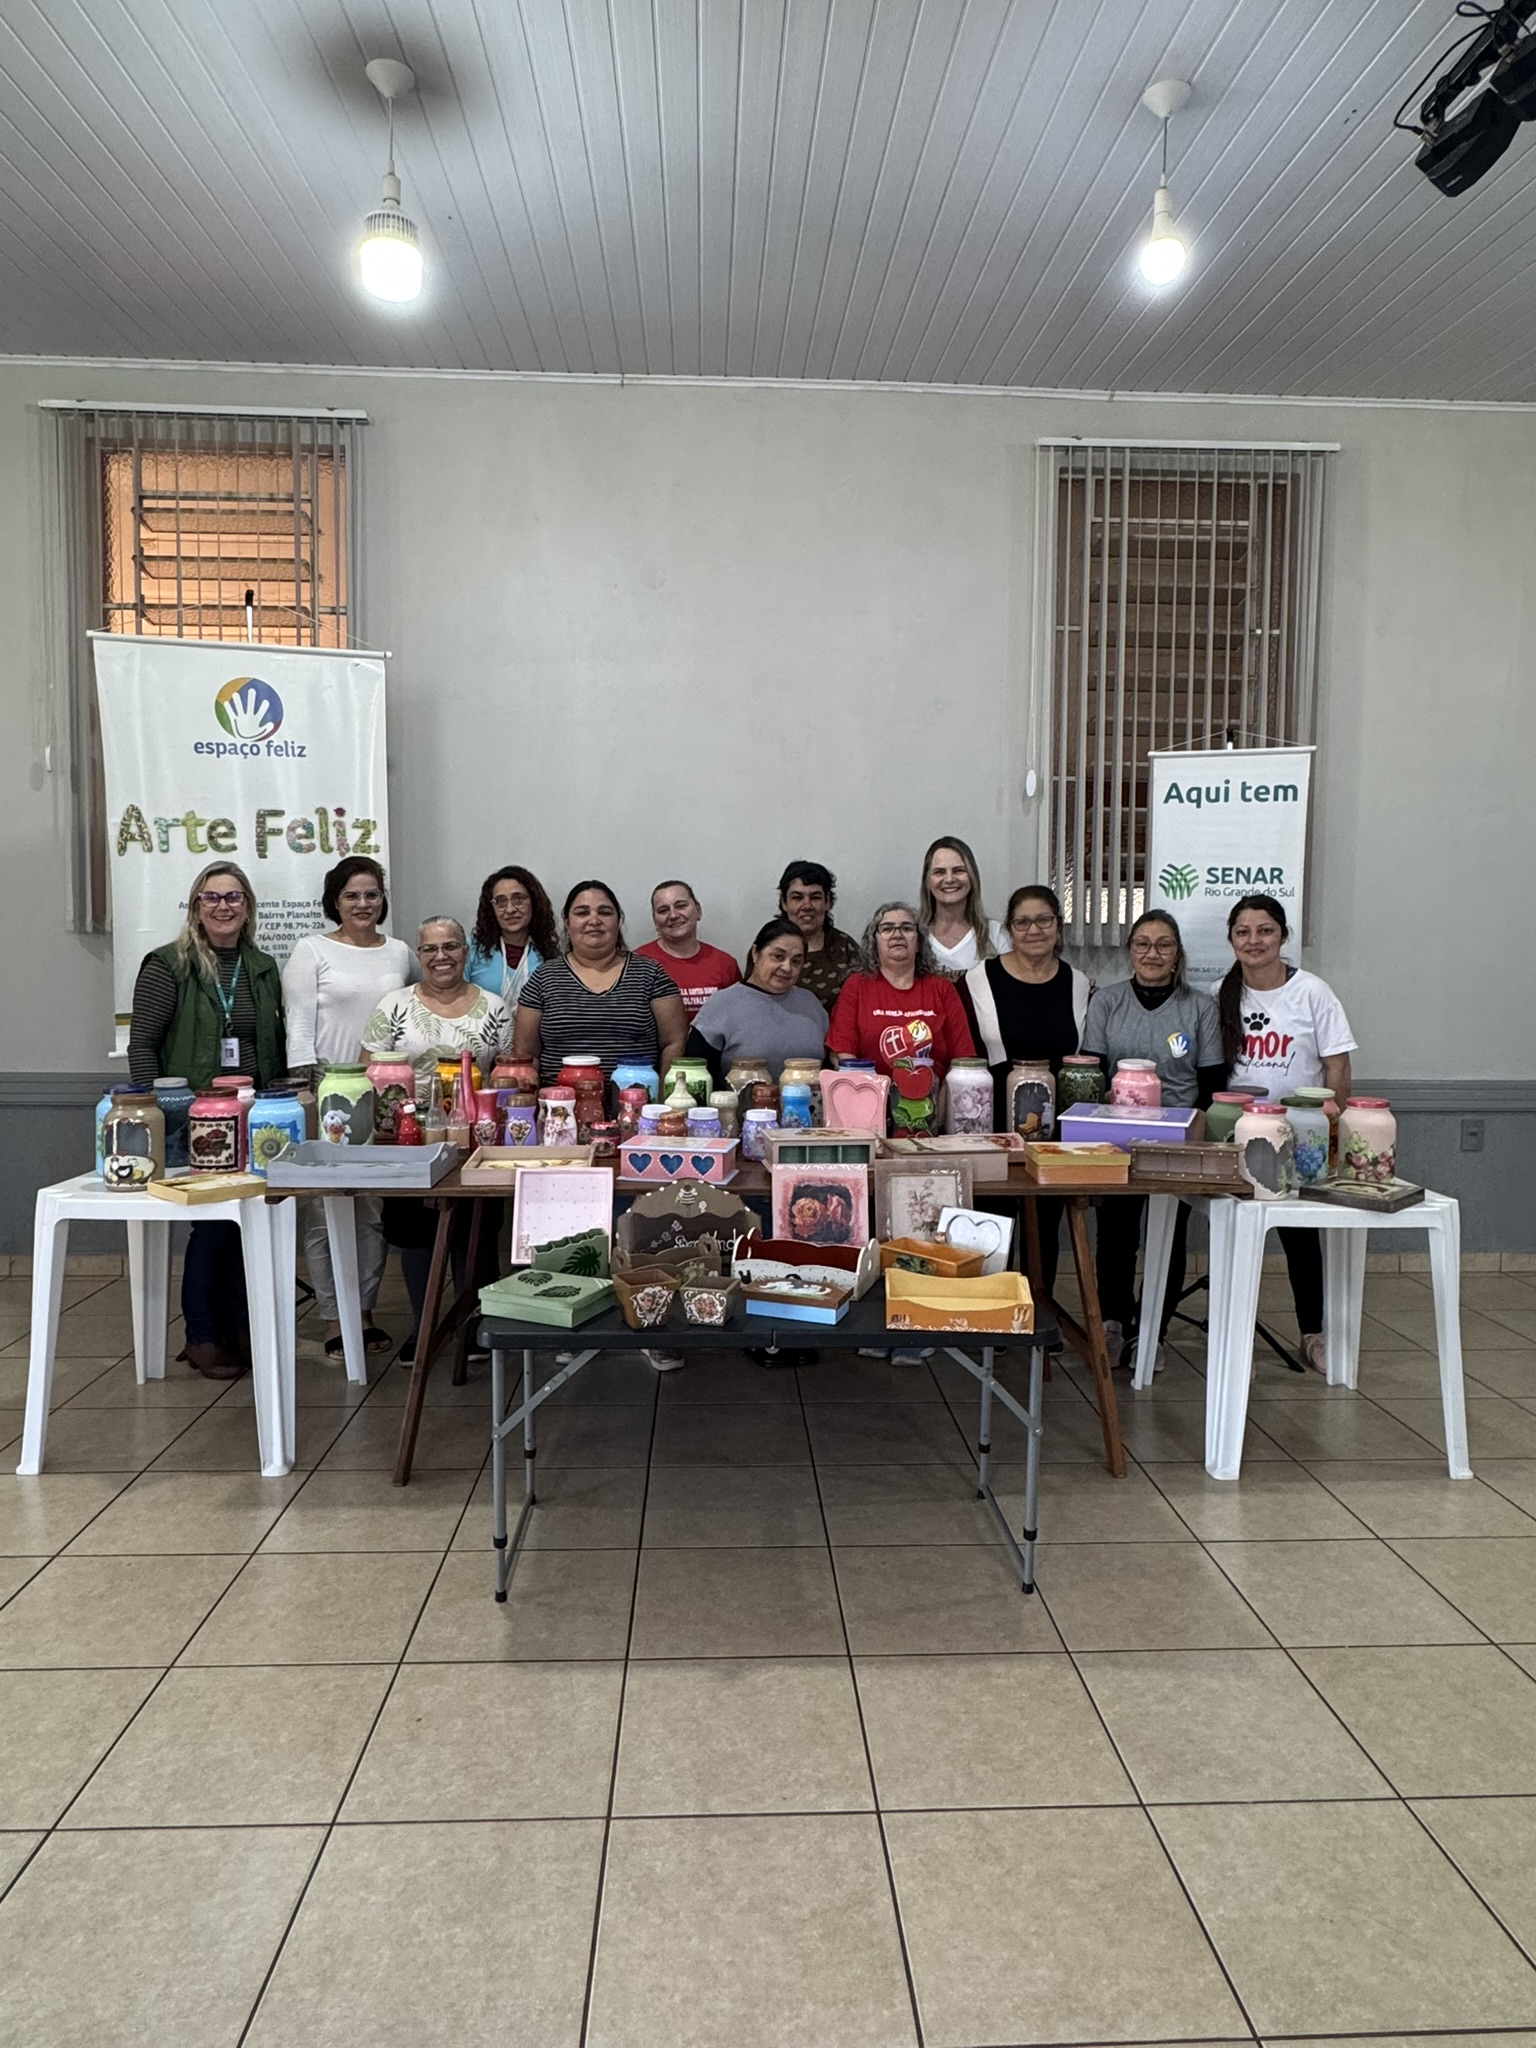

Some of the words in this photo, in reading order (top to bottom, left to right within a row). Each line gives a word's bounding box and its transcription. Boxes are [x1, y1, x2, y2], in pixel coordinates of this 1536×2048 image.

[194, 741, 260, 760] espaço
[266, 740, 307, 758] feliz
[1163, 779, 1230, 808] Aqui
[1241, 781, 1298, 803] tem
[117, 804, 238, 857] Arte
[255, 807, 381, 859] Feliz
[1205, 867, 1284, 885] SENAR
[1204, 887, 1221, 897] Rio
[1223, 887, 1261, 897] Grande
[1263, 887, 1277, 897] do
[1278, 886, 1295, 898] Sul
[282, 901, 312, 910] Espaço
[265, 922, 281, 930] CEP
[1241, 1031, 1294, 1060] mor
